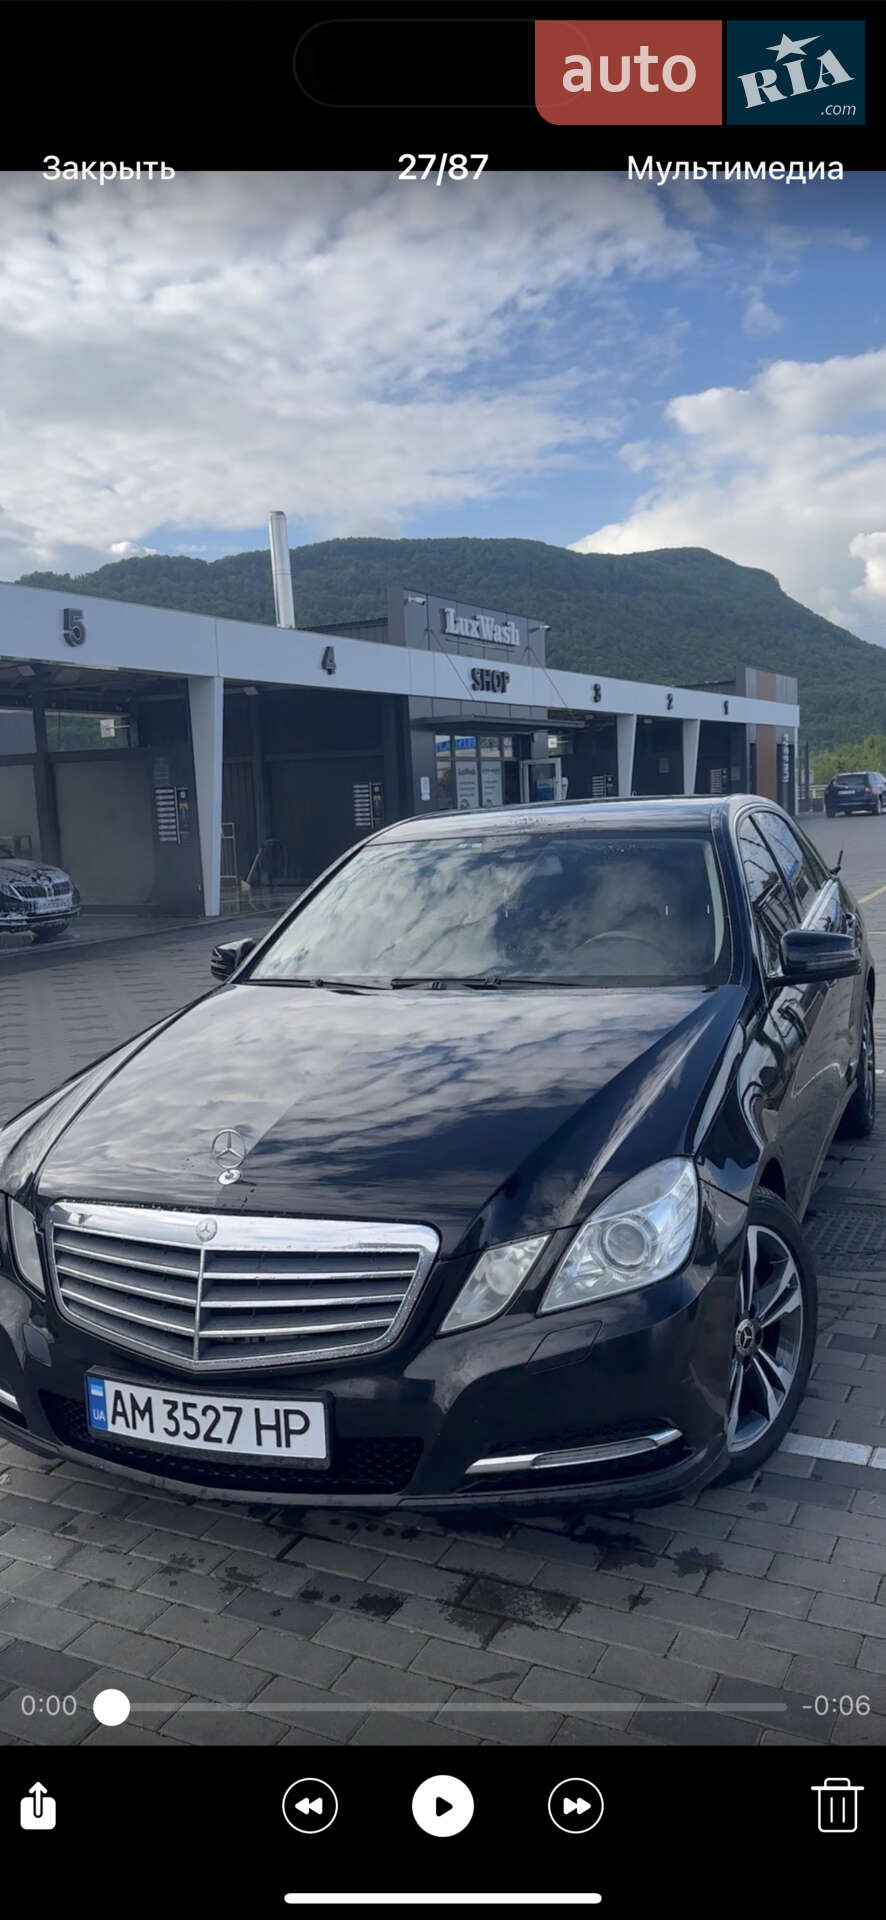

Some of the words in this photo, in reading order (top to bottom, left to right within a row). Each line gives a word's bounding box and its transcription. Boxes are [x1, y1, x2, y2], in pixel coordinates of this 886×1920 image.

[63, 608, 86, 647] 5
[442, 608, 520, 646] LuxWash
[321, 646, 336, 675] 4
[470, 667, 510, 693] SHOP
[93, 1409, 106, 1422] UA
[110, 1389, 155, 1434] AM
[162, 1398, 243, 1445] 3527
[254, 1407, 310, 1448] HP
